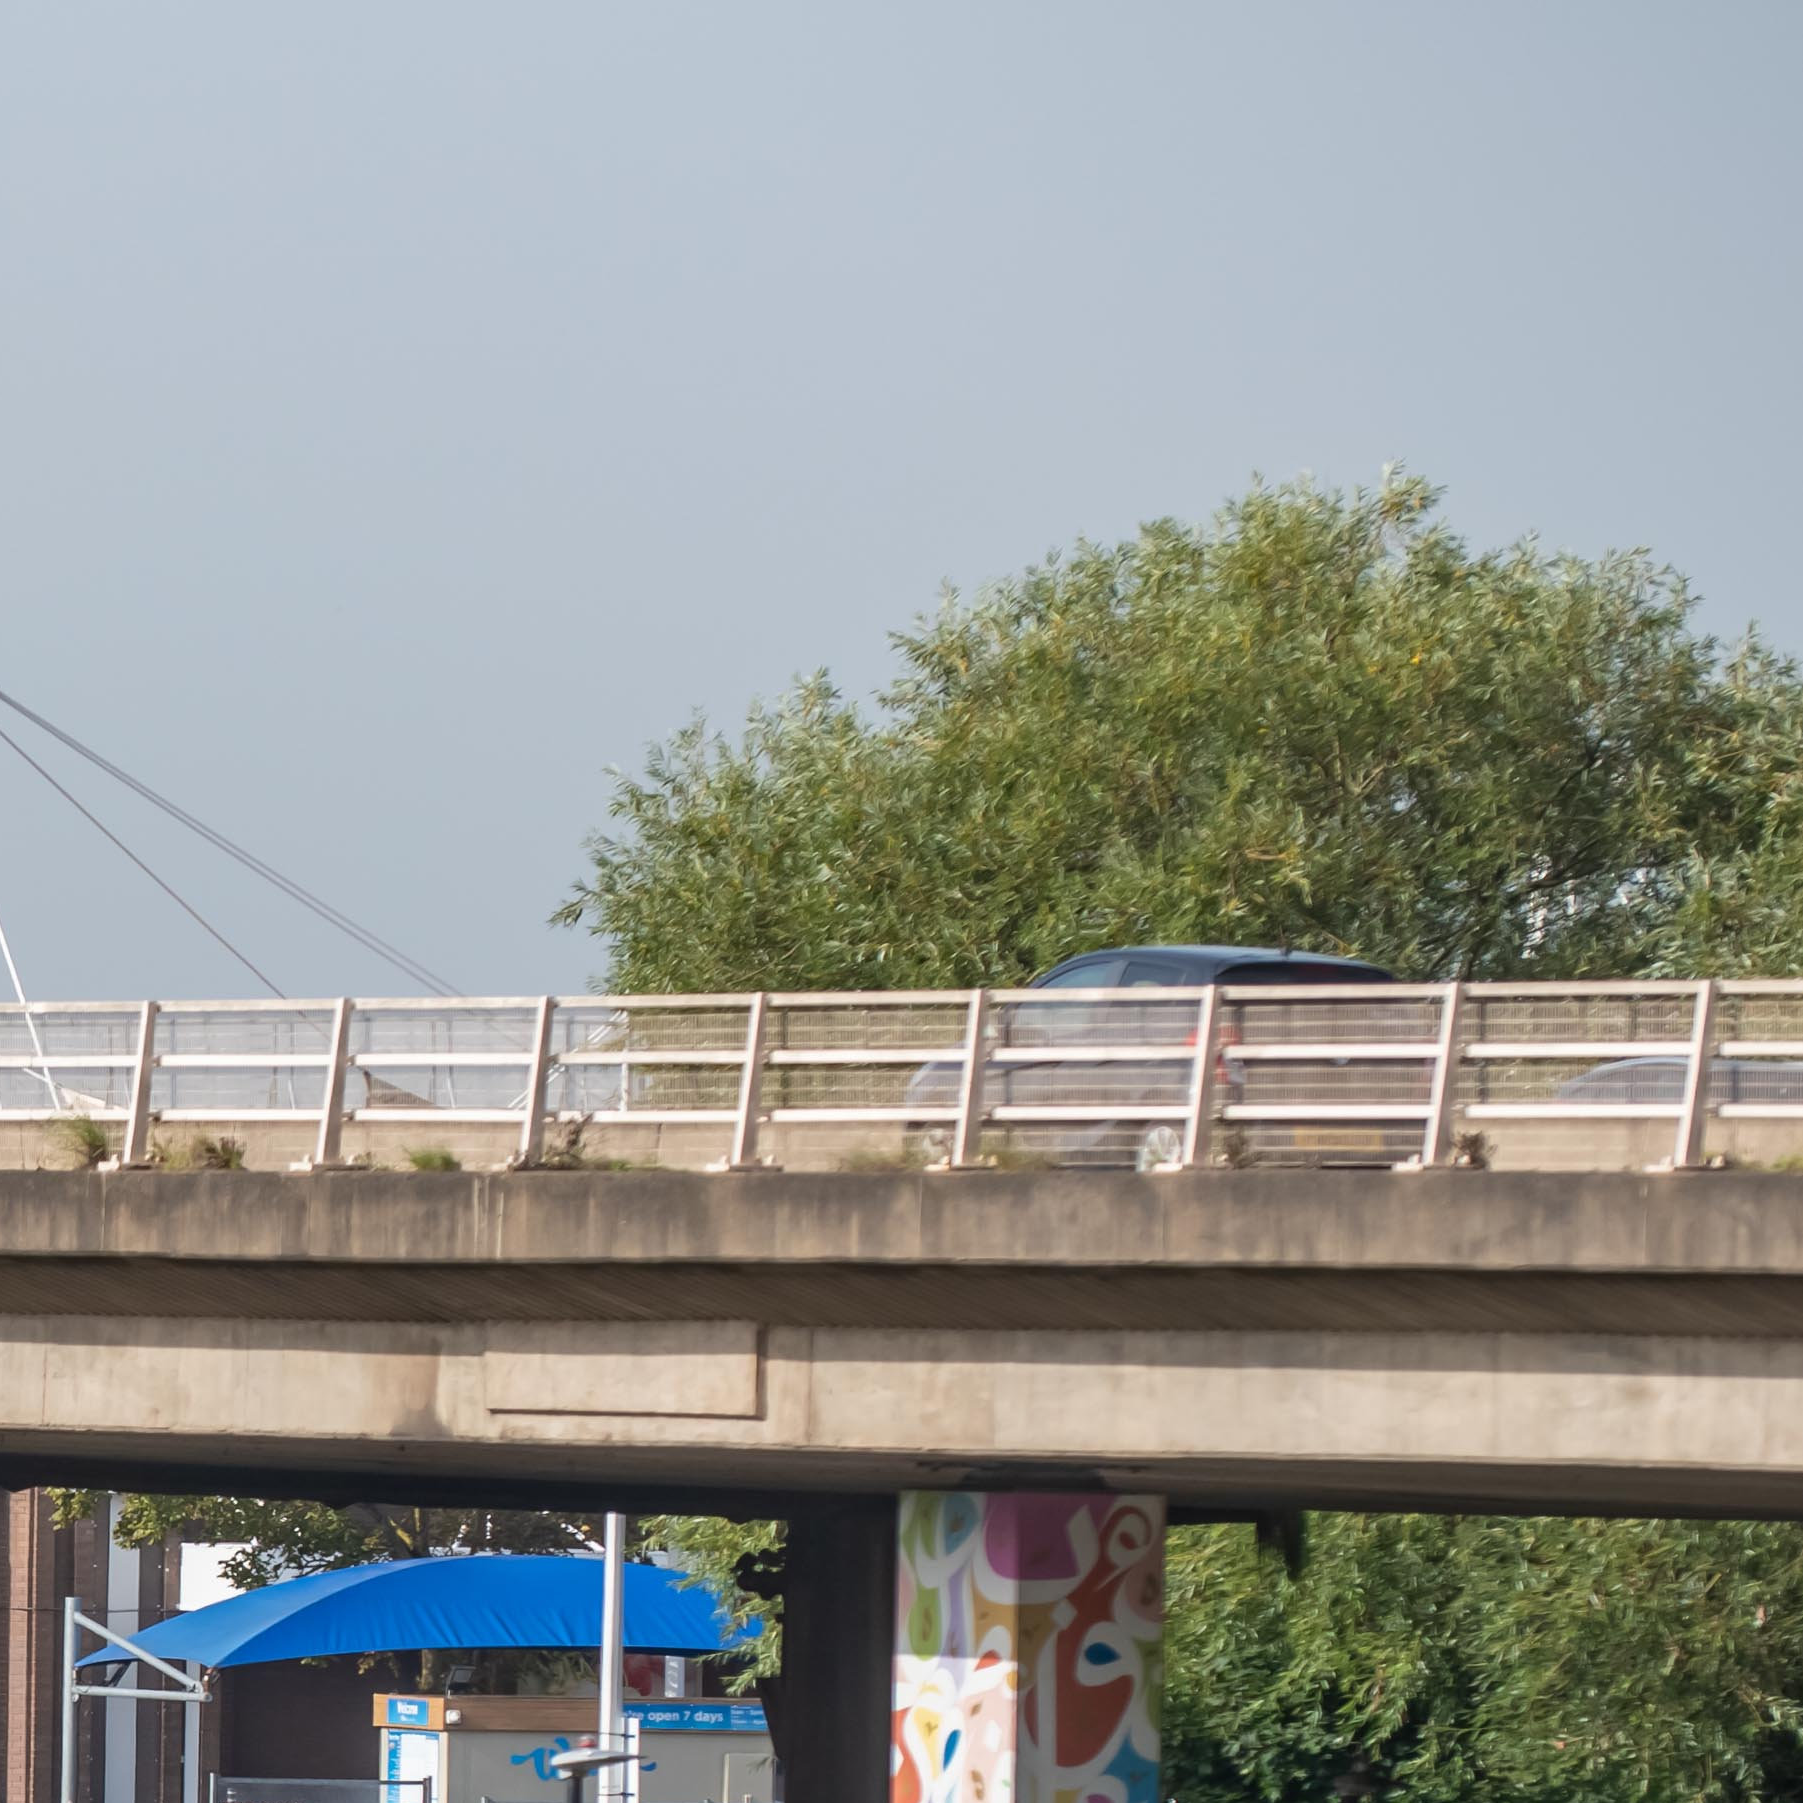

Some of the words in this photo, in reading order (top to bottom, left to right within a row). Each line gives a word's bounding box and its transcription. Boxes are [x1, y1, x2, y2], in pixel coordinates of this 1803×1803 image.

[647, 1711, 680, 1723] open
[683, 1711, 691, 1721] 7
[694, 1709, 724, 1723] days
